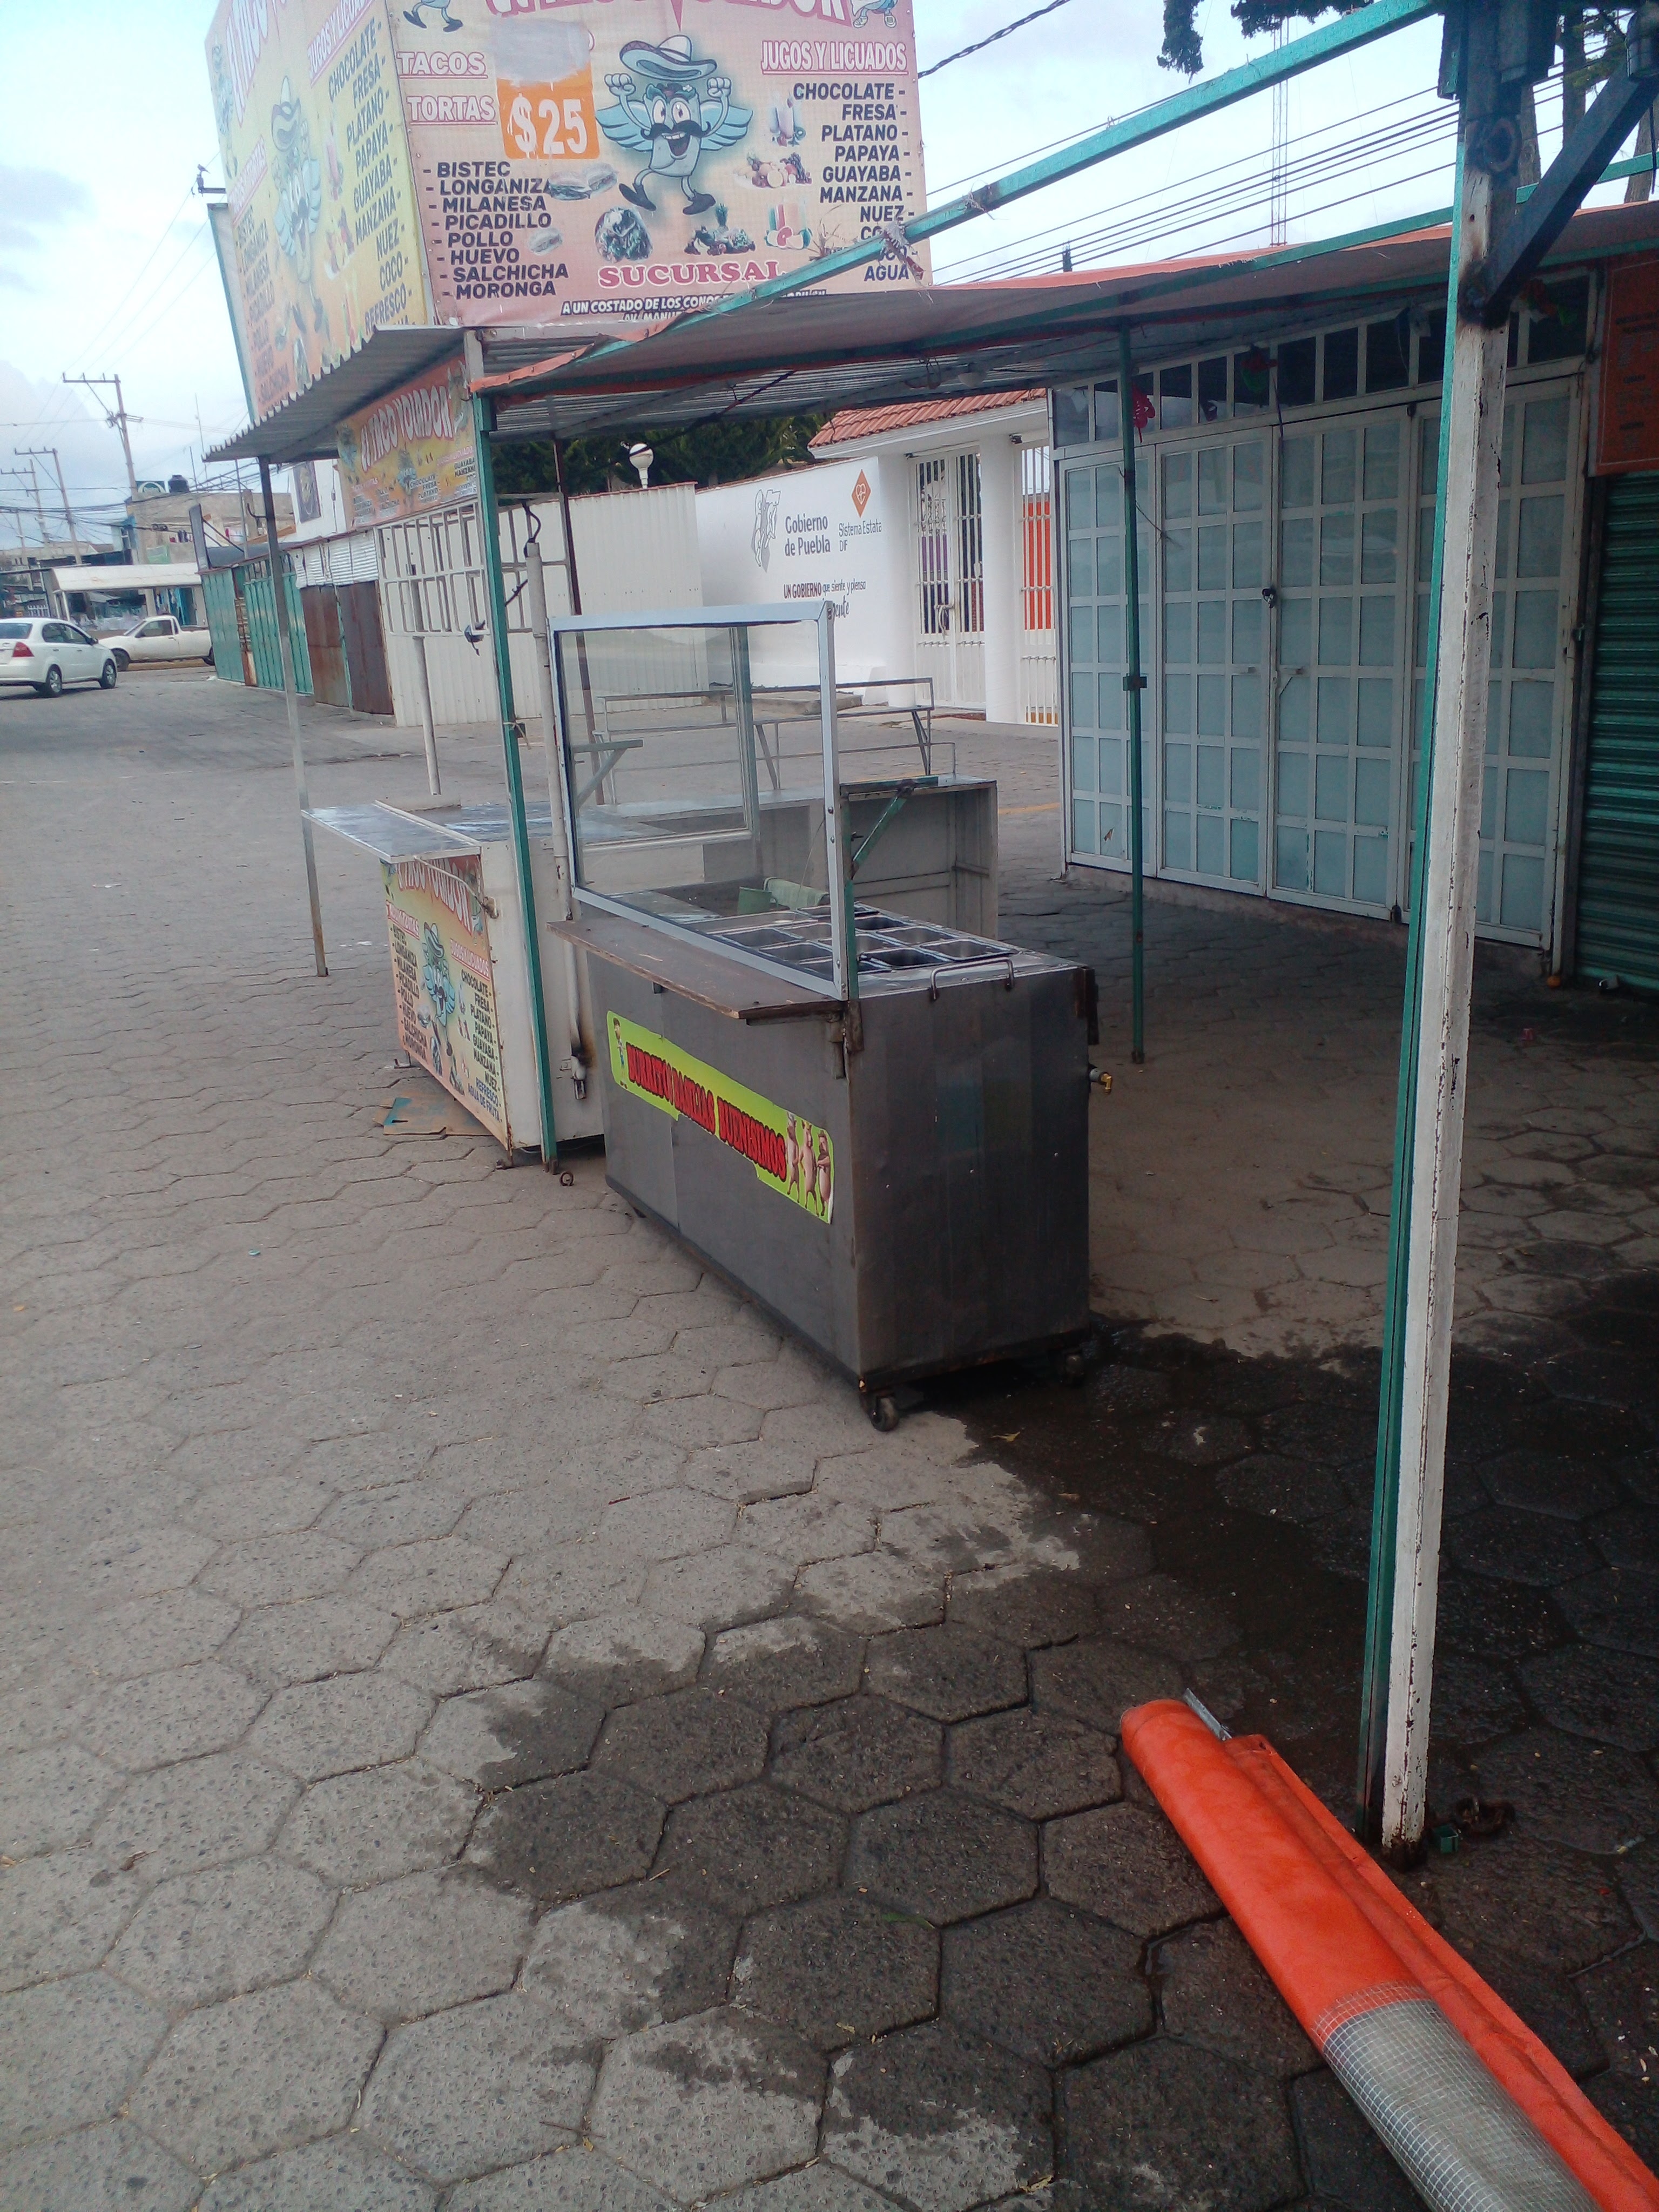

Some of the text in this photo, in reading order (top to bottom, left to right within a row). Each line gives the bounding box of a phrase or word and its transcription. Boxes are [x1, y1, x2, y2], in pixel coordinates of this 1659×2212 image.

[328, 16, 377, 103] CHOCOLATE
[396, 51, 486, 75] TACOS
[761, 41, 907, 71] JUGOS Y LICUADOS
[353, 52, 381, 109] FRESA
[793, 83, 894, 100] CHOCOLATE
[347, 86, 384, 152] PLATANO
[406, 96, 496, 122] TORTAS
[842, 104, 896, 120] FRESA
[508, 93, 589, 158] $25
[821, 125, 898, 142] PLATANO
[355, 120, 389, 177] PAPAYA
[834, 145, 900, 162] PAPAYA
[437, 161, 511, 178] BISTEC
[822, 165, 901, 183] GUAYABA
[354, 153, 393, 213] GUAYABA
[440, 178, 552, 195] LONGANIZA
[442, 195, 547, 213] MILANESA
[820, 185, 903, 203] MANZANA
[355, 186, 396, 245] MANZANA
[445, 213, 552, 231] PICADILLO
[860, 205, 905, 222] NUEZ
[376, 218, 400, 261] NUEZ
[448, 231, 513, 248] POLLO
[450, 248, 520, 265] HUEVO
[380, 251, 403, 292] COCO
[453, 263, 569, 282] SALCHICHA
[598, 261, 785, 289] SUCURSAL
[864, 265, 909, 282] AGUA
[456, 280, 556, 300] MORONGA
[365, 282, 406, 335] REFRESCO
[561, 301, 571, 316] A
[571, 300, 590, 315] UN
[590, 298, 644, 314] COSTADO
[644, 296, 660, 311] DE
[660, 295, 682, 309] LOS
[785, 513, 828, 534] Gobierno
[839, 522, 862, 537] Sistema
[785, 535, 831, 557] de Puebla
[839, 539, 848, 552] DIF
[784, 584, 792, 599] UN
[792, 582, 822, 598] GOBIERNO
[822, 584, 831, 596] que
[831, 579, 846, 592] siente
[461, 969, 489, 997] CHOCOLATE
[474, 992, 490, 1013] FRESA
[470, 1004, 492, 1029] PLATANO
[475, 1021, 494, 1044] PAPAYA
[473, 1034, 495, 1061] GUAYABA
[473, 1048, 496, 1077] MANZANA
[484, 1070, 498, 1092] NUEZ
[476, 1077, 499, 1107] REFRESCO
